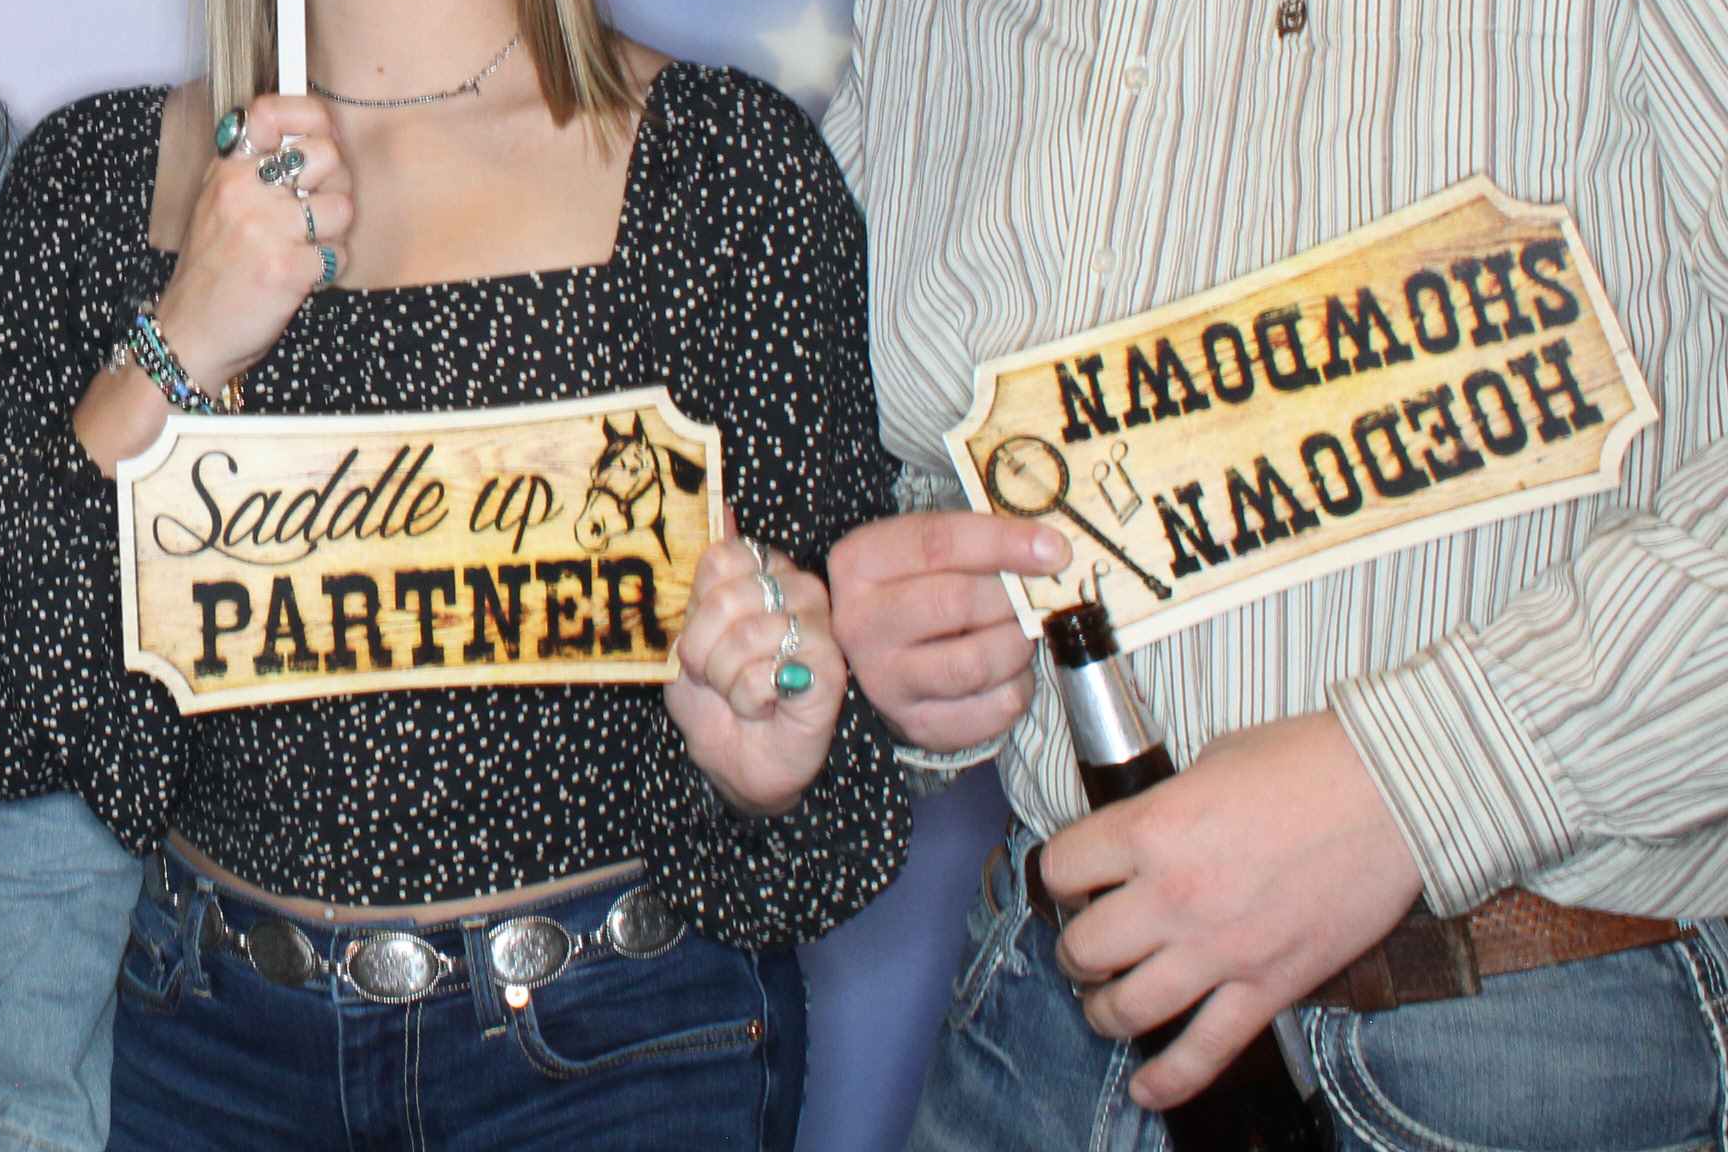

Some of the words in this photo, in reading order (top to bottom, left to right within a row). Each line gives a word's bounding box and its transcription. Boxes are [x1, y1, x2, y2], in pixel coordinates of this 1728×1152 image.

[1054, 237, 1582, 444] SHOWDOWN
[152, 443, 450, 566] Saddle
[470, 473, 565, 554] up
[1152, 337, 1603, 580] HOEDOWN
[192, 556, 673, 679] PARTNER
